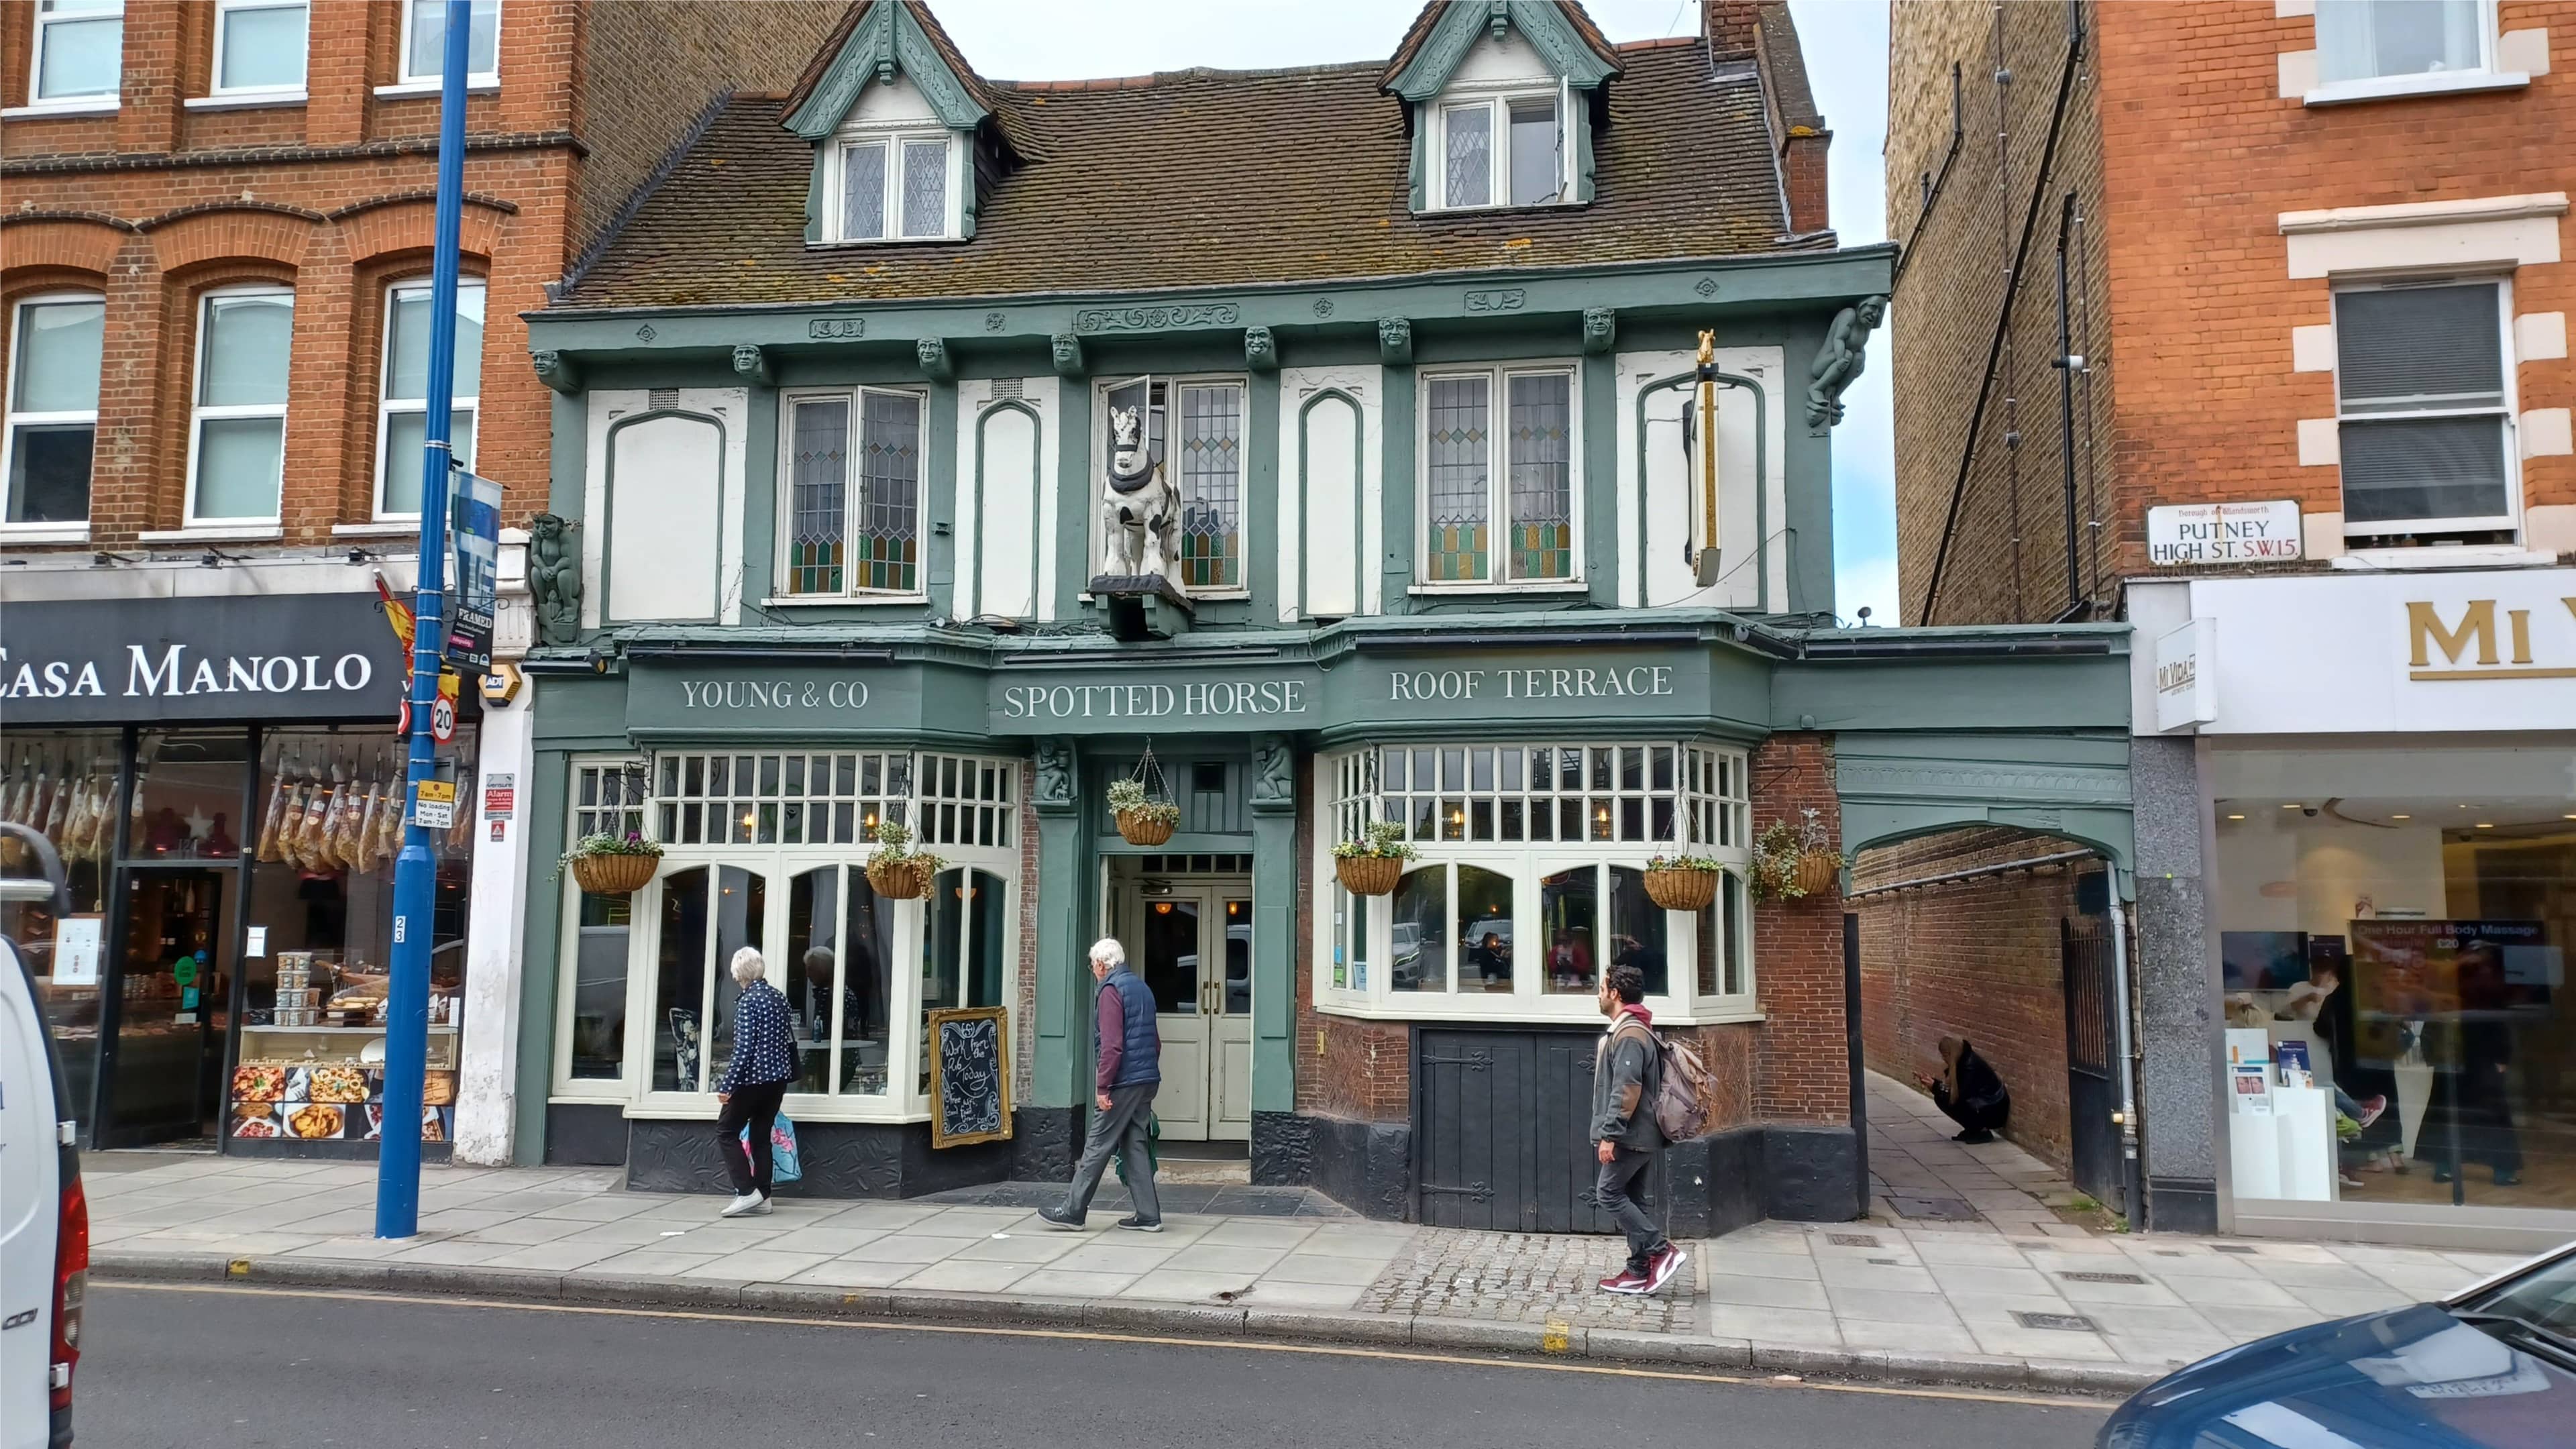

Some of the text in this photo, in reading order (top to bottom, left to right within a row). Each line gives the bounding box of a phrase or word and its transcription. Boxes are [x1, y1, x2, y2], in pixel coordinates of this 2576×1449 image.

[2178, 508, 2208, 518] Borough
[2179, 520, 2270, 540] PUTNEY
[2154, 542, 2202, 561] HIGH
[2211, 541, 2238, 559] ST.
[458, 608, 492, 629] FRAMED
[0, 644, 372, 698] ASA MANOLO
[486, 676, 504, 686] ADT
[2169, 660, 2189, 684] VIDA
[1389, 666, 1674, 701] ROOF TERRACE
[680, 680, 869, 709] YOUNG & CO
[1004, 680, 1307, 718] SPOTTED HORSE
[436, 709, 451, 730] 20
[429, 803, 450, 811] loading
[2358, 924, 2538, 936] One Hour Full Body Massage
[945, 1040, 971, 1061] Work
[973, 1047, 985, 1059] the
[947, 1055, 962, 1078] Pub
